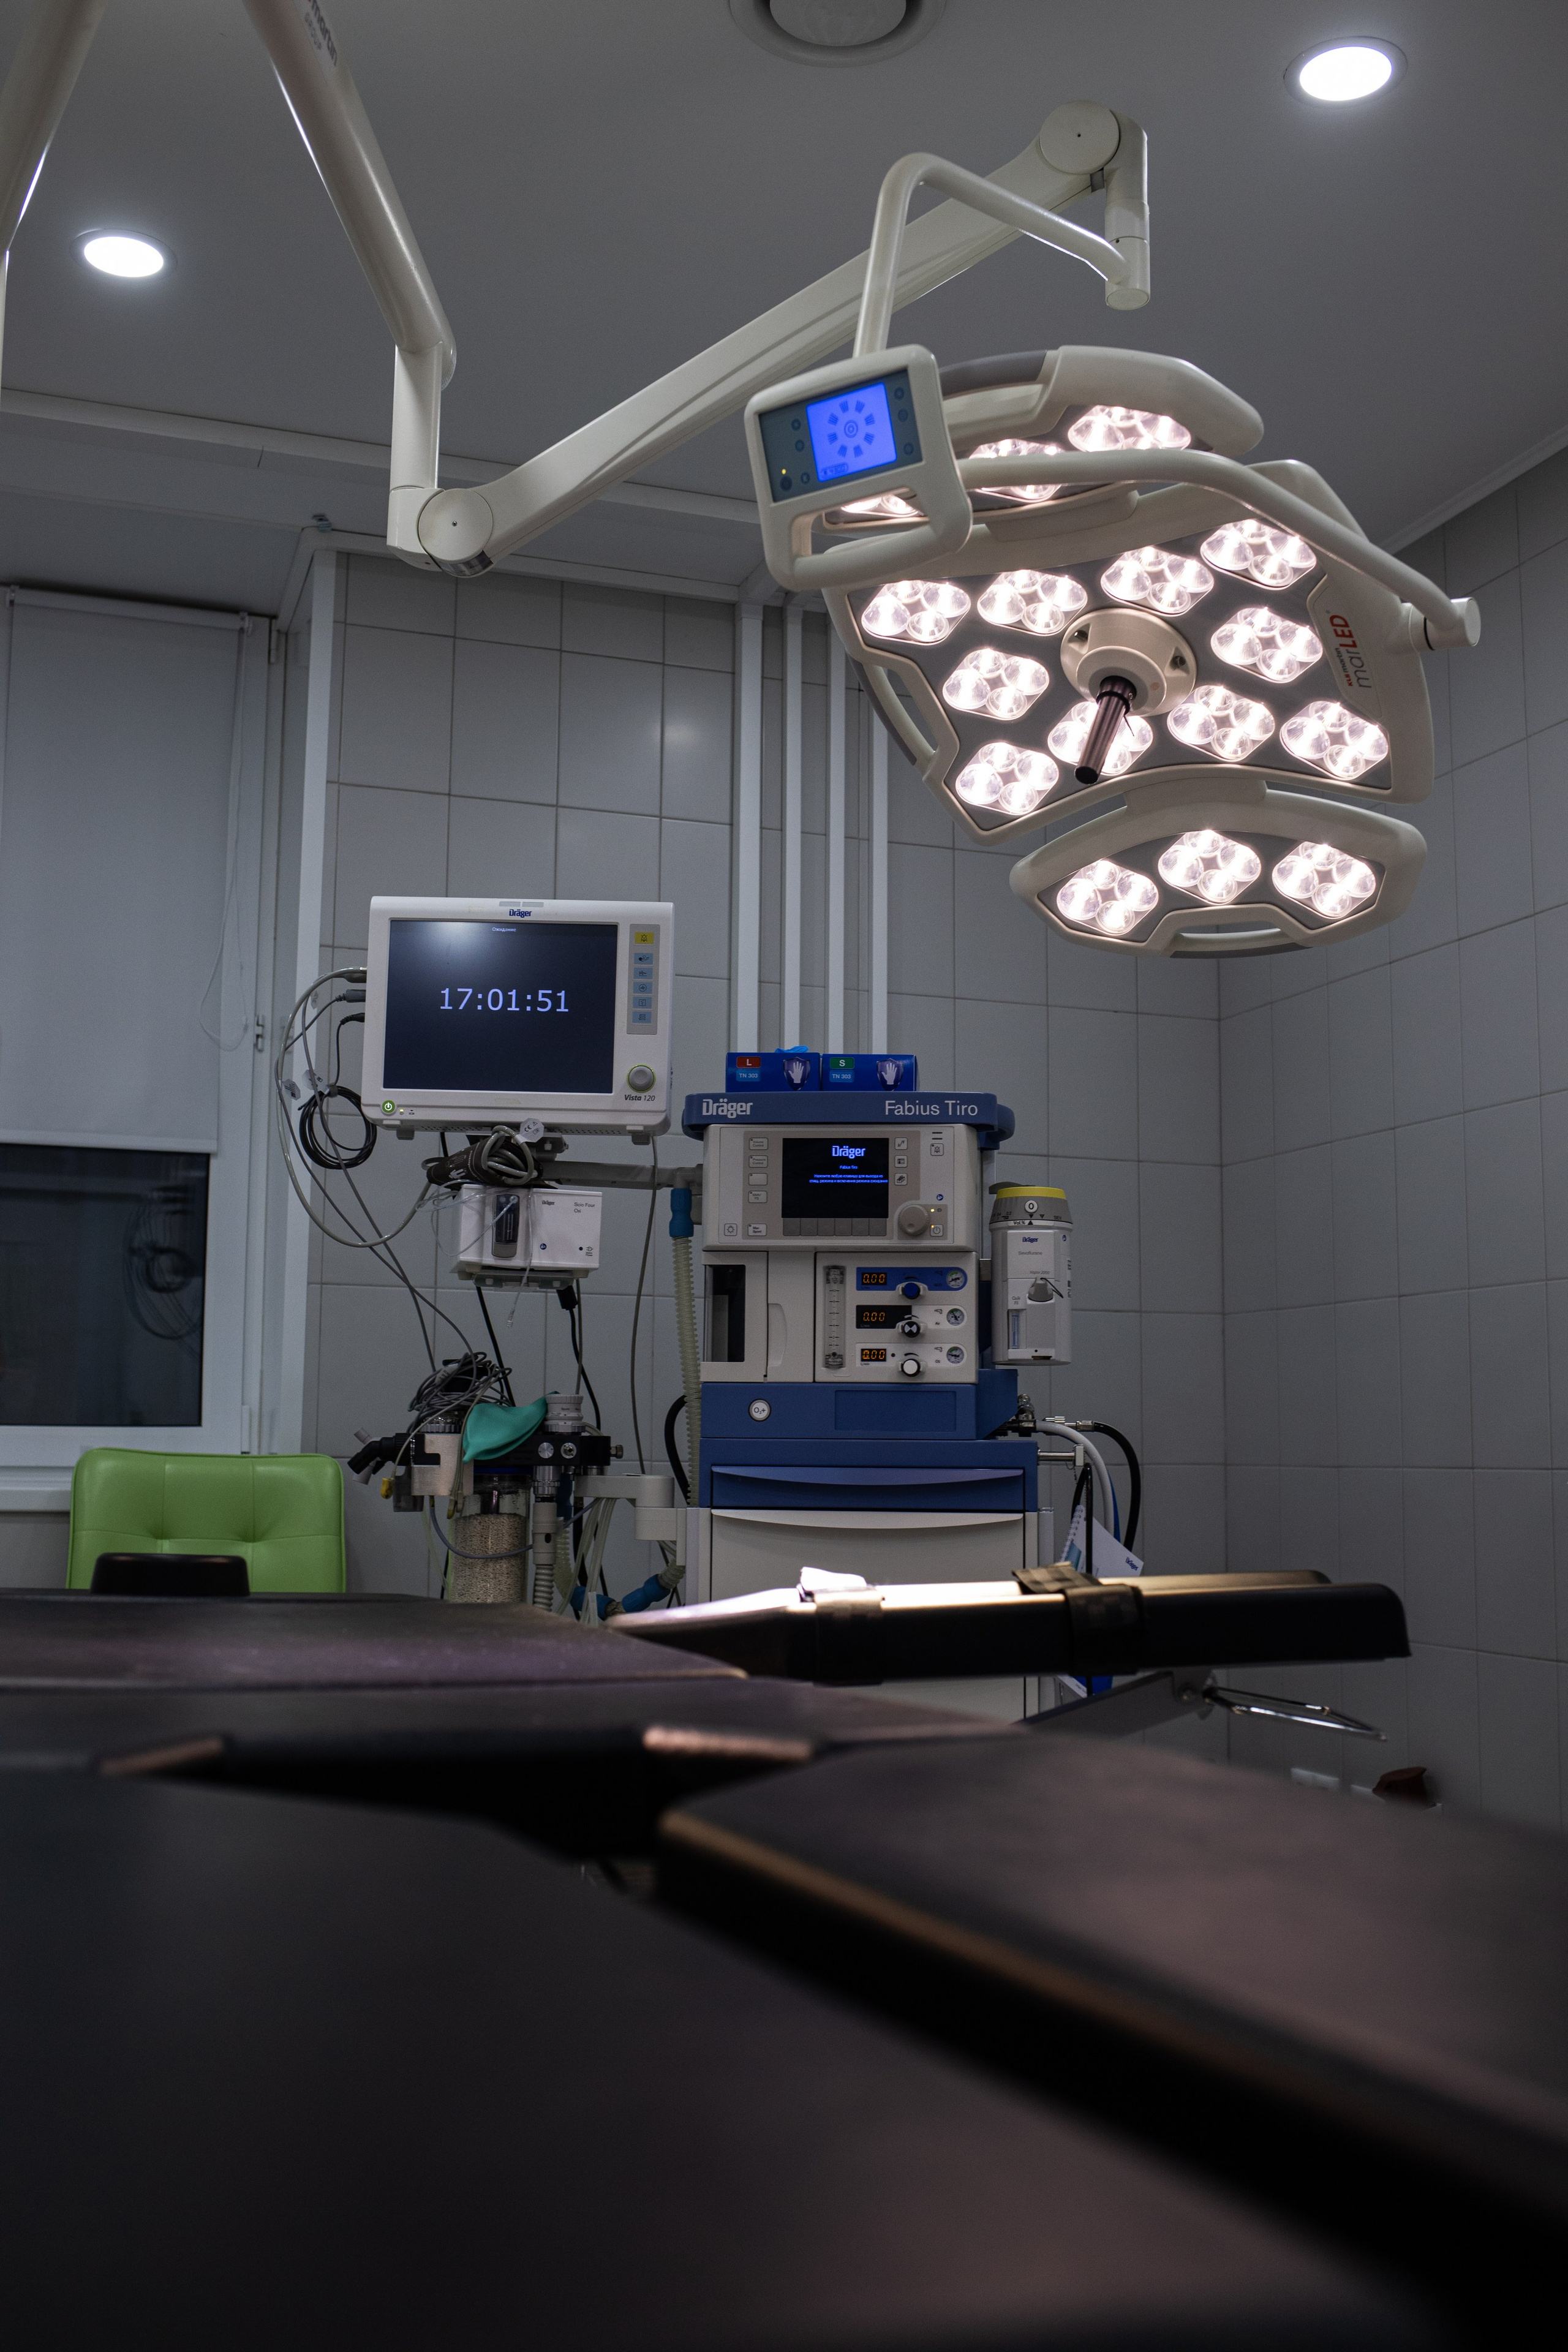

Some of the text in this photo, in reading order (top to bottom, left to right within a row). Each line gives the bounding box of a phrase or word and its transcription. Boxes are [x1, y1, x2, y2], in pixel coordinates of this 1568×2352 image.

[1335, 647, 1349, 673] martin
[509, 909, 532, 918] Dräger
[440, 987, 569, 1012] 17:01:51
[702, 1098, 753, 1119] Dräger
[885, 1100, 979, 1116] Fabius Tiro
[832, 1145, 866, 1159] Dräger
[863, 1274, 886, 1283] 0.00
[863, 1312, 886, 1321] 0.00
[862, 1350, 886, 1359] 0.00
